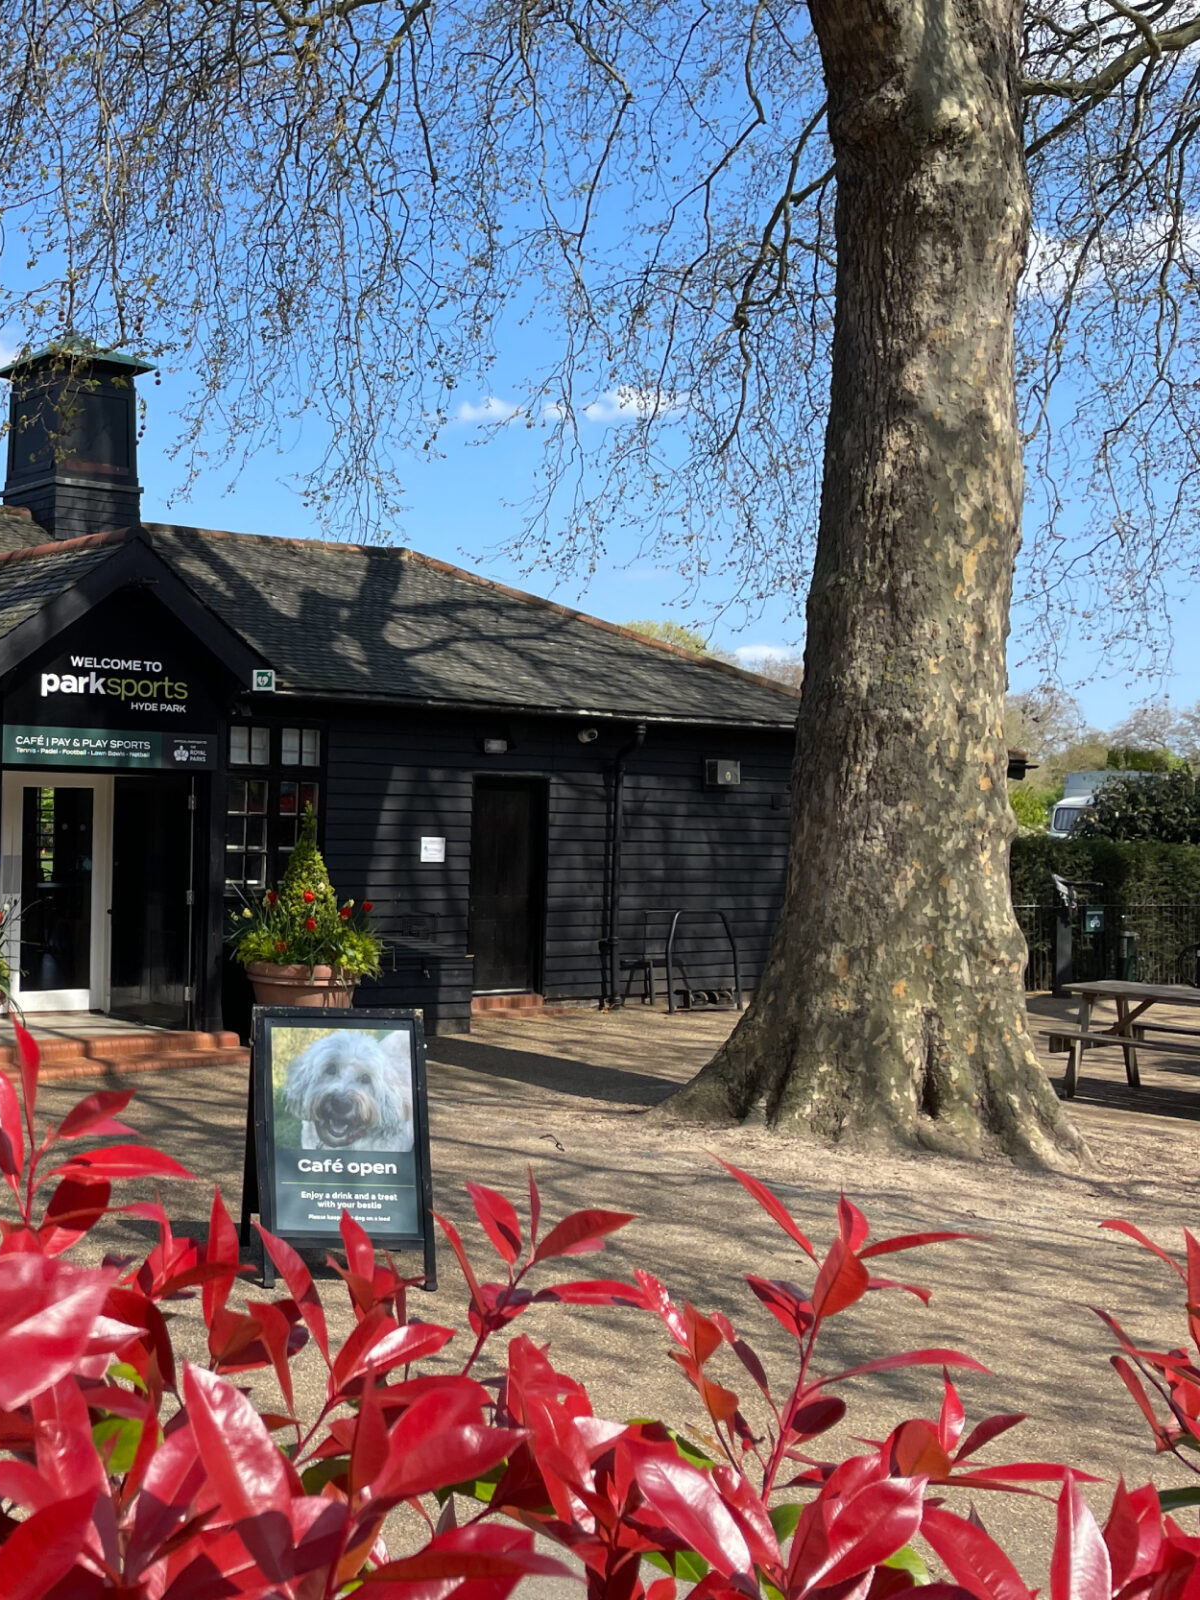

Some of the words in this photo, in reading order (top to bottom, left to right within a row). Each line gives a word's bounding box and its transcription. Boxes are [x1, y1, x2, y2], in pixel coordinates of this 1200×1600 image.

[70, 655, 142, 671] WELCOME
[144, 661, 163, 673] TO
[40, 671, 189, 701] parksports
[131, 702, 158, 711] HYDE
[160, 703, 186, 713] PARK
[15, 735, 45, 746] CAFÉ
[51, 737, 71, 747] PAY
[72, 738, 80, 747] &
[82, 738, 108, 748] PLAY
[109, 739, 151, 750] SPORTS
[297, 1158, 344, 1173] Café
[347, 1161, 397, 1176] open
[301, 1191, 324, 1200] Enjoy
[377, 1193, 398, 1201] treat
[357, 1201, 382, 1209] bestie
